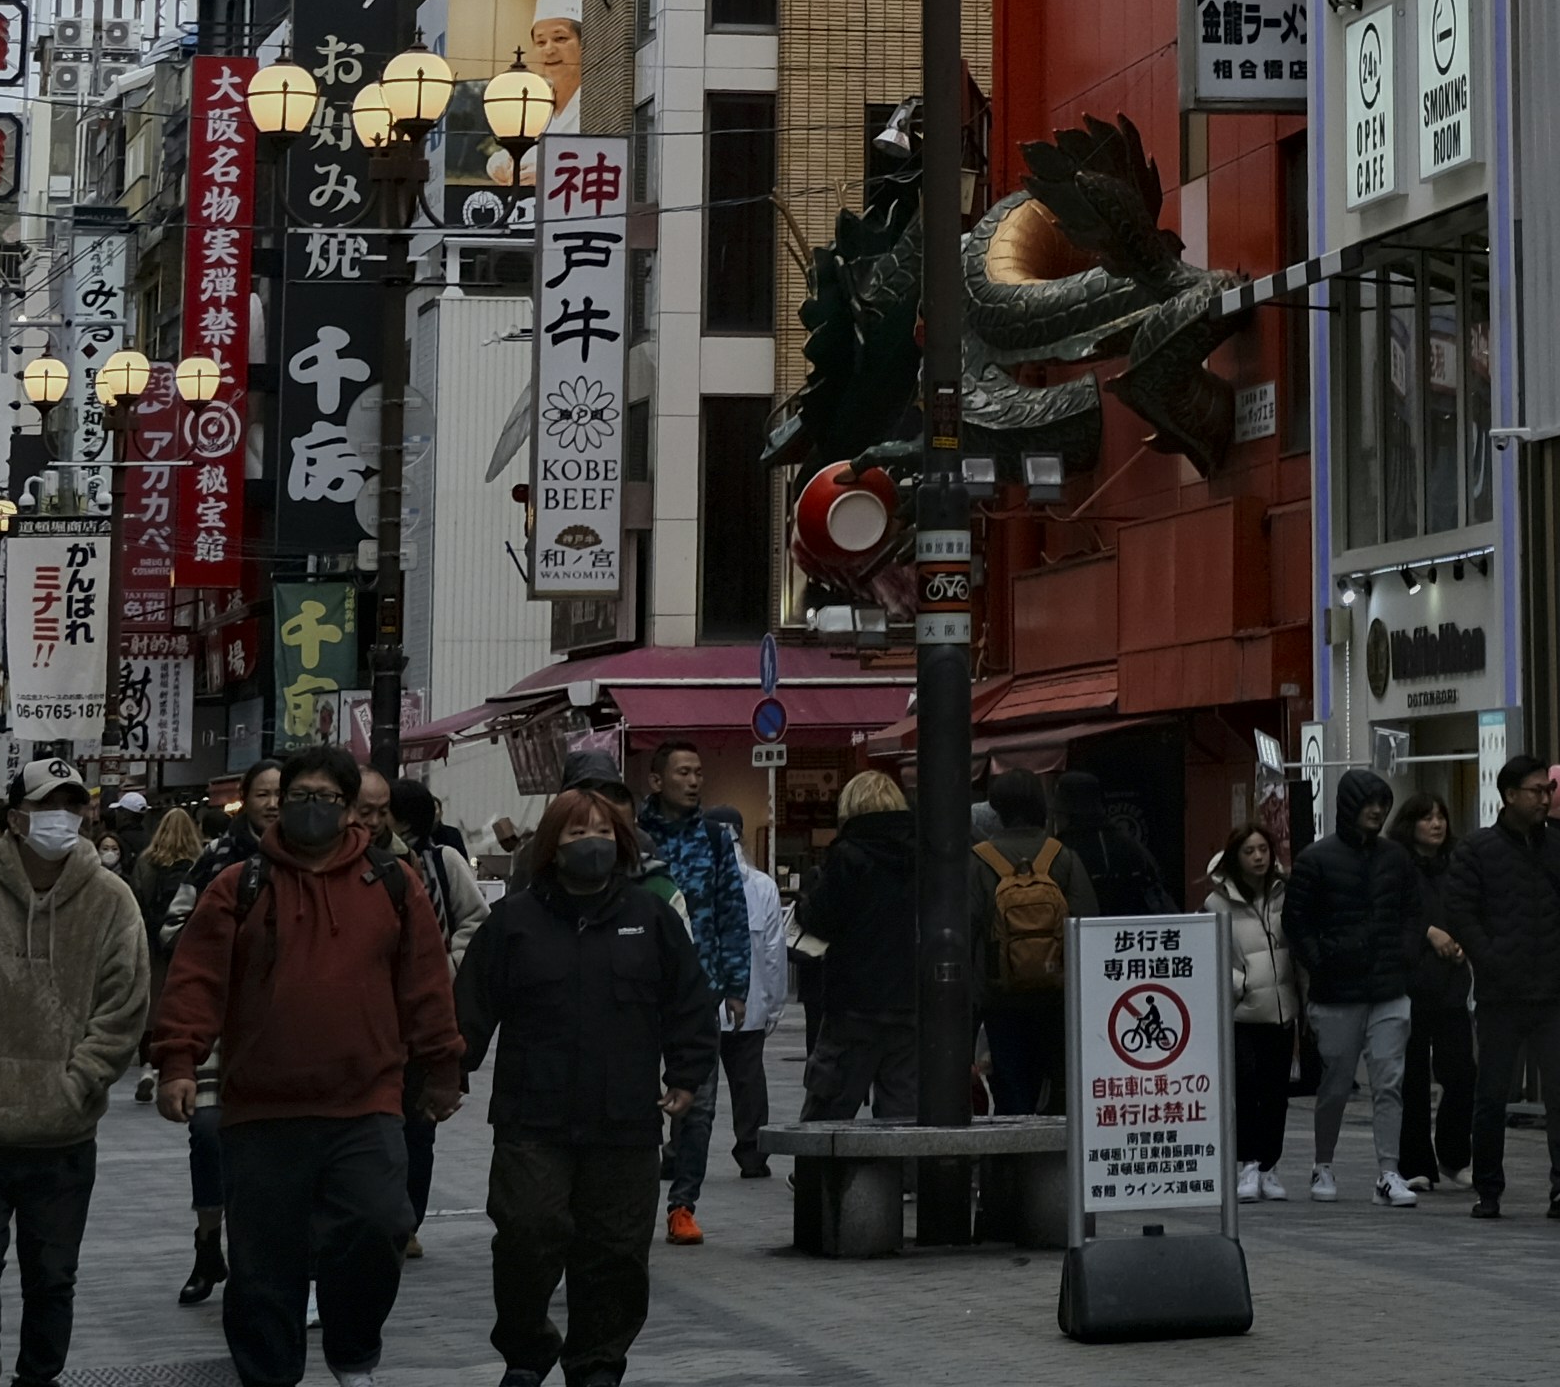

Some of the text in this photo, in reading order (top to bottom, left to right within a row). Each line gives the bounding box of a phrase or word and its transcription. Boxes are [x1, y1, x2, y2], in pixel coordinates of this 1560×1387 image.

[1424, 74, 1468, 129] SMOKING
[1357, 112, 1386, 158] OPEN
[1433, 120, 1461, 168] ROOM
[1356, 151, 1385, 199] CAFE
[544, 150, 623, 363] 神戸牛
[288, 326, 371, 503] 千房
[541, 460, 618, 482] KOBE
[194, 465, 228, 564] 秘宝館
[543, 488, 614, 511] BEEF
[65, 542, 96, 645] がんばれ
[540, 570, 617, 581] WANOMIYA
[1114, 929, 1181, 952] 歩行者
[1103, 955, 1194, 980] 専用道路
[1092, 1073, 1210, 1099] 自転車に乗っての
[1095, 1100, 1207, 1127] 通行は禁止
